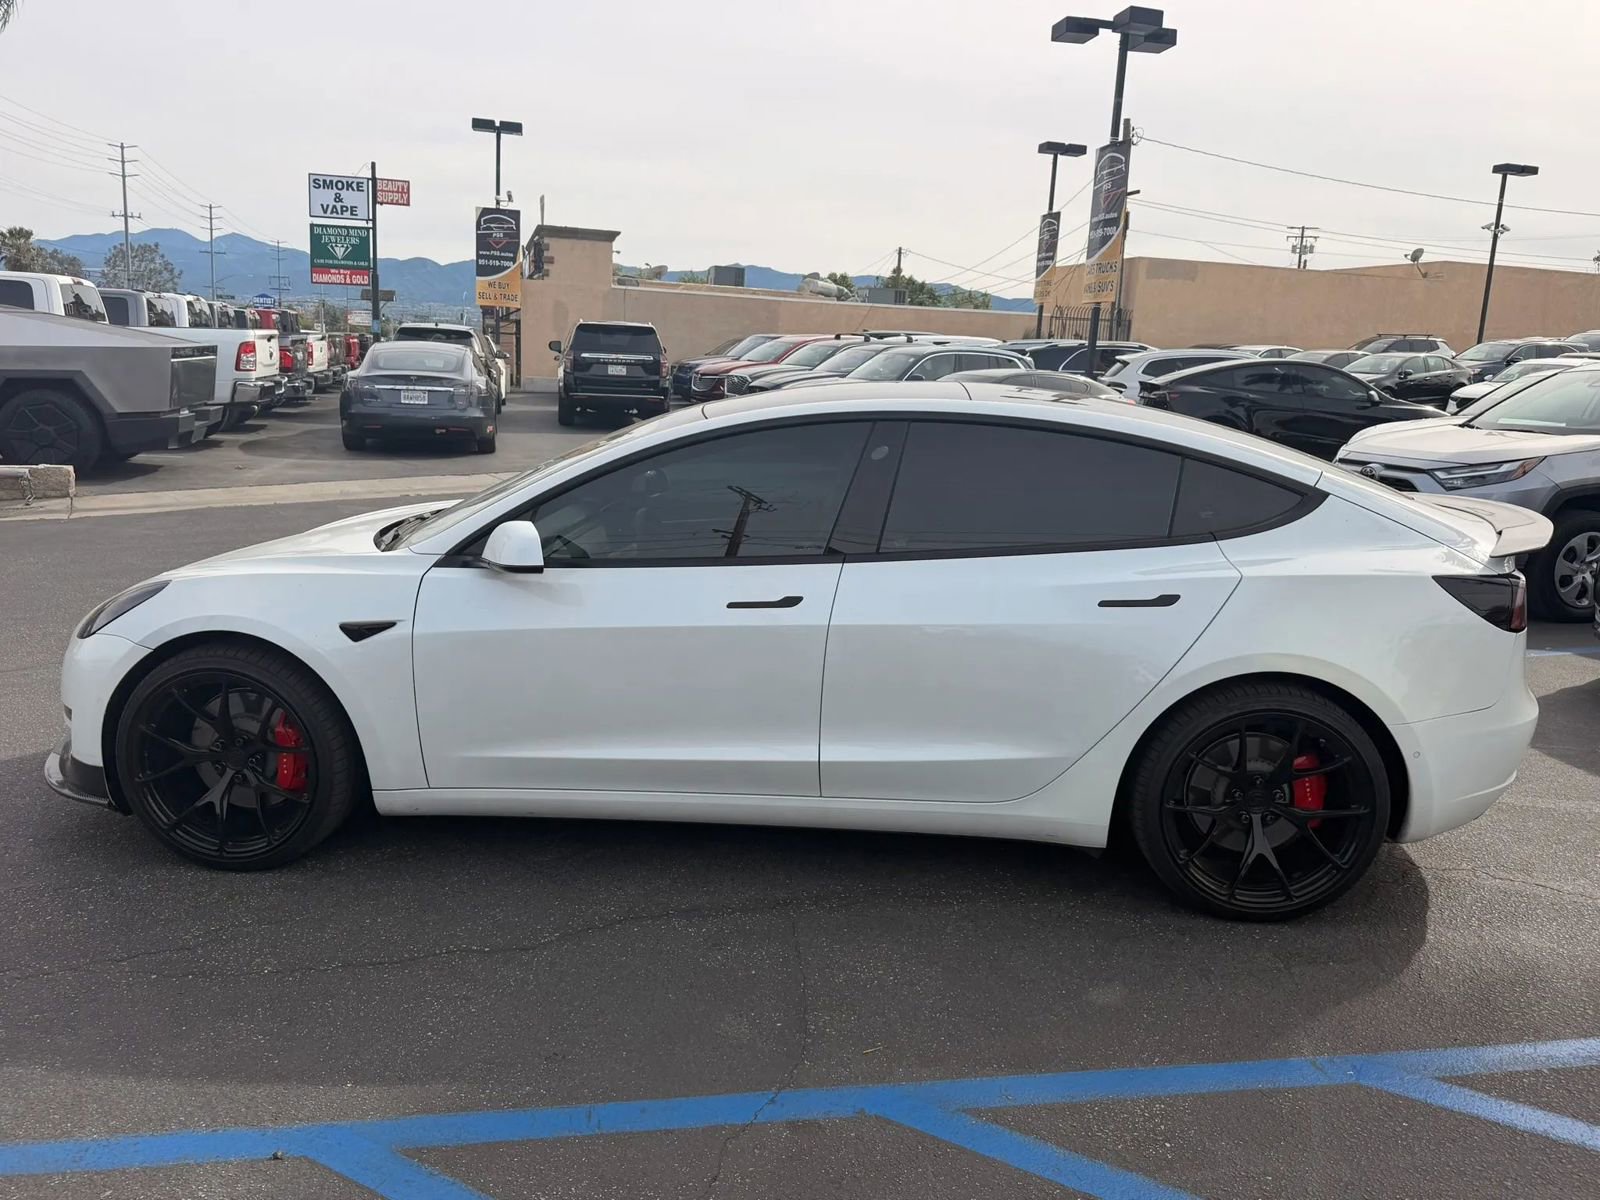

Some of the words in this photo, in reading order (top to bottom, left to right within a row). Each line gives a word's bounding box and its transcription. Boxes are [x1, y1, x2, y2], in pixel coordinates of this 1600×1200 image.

[312, 178, 365, 192] SMOKE
[377, 180, 409, 192] BEAUTY
[333, 192, 344, 203] &
[377, 192, 409, 204] SUPPLY
[320, 203, 359, 217] VAPE
[314, 226, 347, 236] DIAMOND
[348, 228, 367, 237] MIND
[321, 235, 360, 244] JEWELERS
[312, 273, 344, 283] DIAMONDS
[345, 274, 351, 283] &
[352, 275, 369, 285] GOLD
[498, 281, 509, 289] BUY
[478, 292, 491, 300] SELL
[500, 293, 518, 302] TRADE
